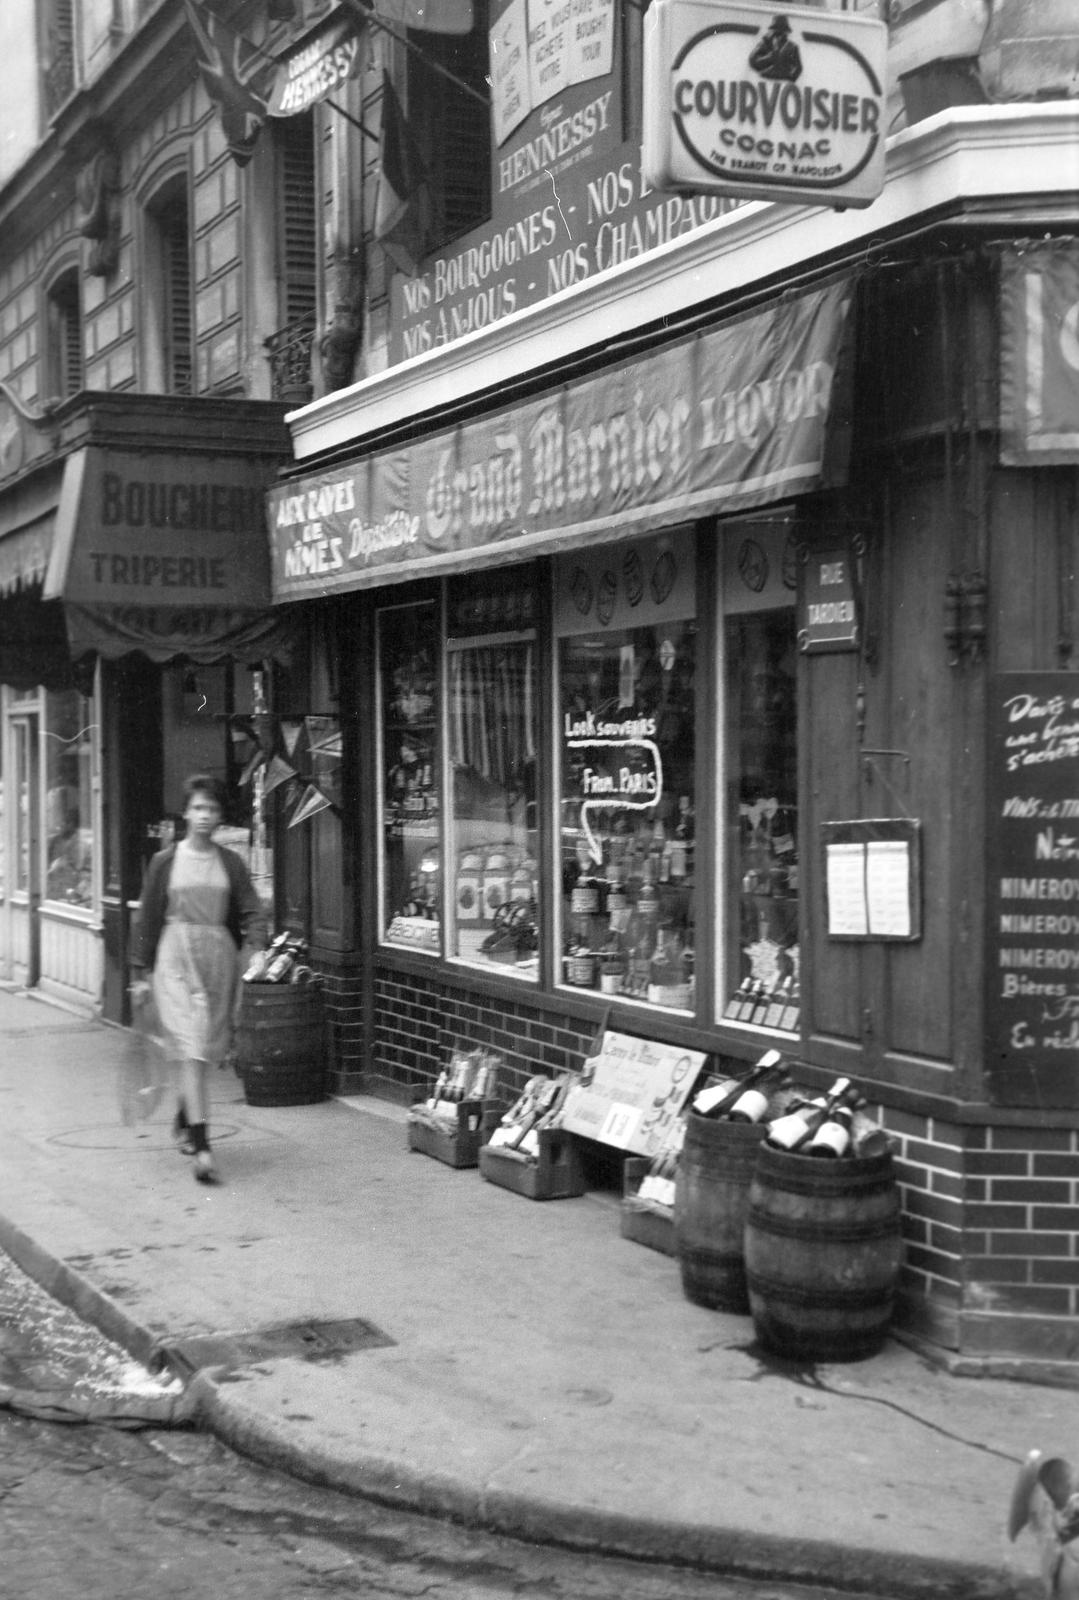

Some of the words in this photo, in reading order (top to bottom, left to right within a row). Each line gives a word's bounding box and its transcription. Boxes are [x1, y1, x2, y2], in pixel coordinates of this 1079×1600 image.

[674, 79, 880, 133] COURVOISIER
[499, 91, 612, 192] HENNESSY
[708, 150, 726, 166] THE
[718, 128, 831, 159] COGNAC
[434, 205, 557, 303] BOURGOGNES
[586, 163, 634, 225] NOS
[435, 278, 517, 346] ANJOUS
[547, 242, 590, 298] NOS
[90, 553, 226, 589] TRIPERIE
